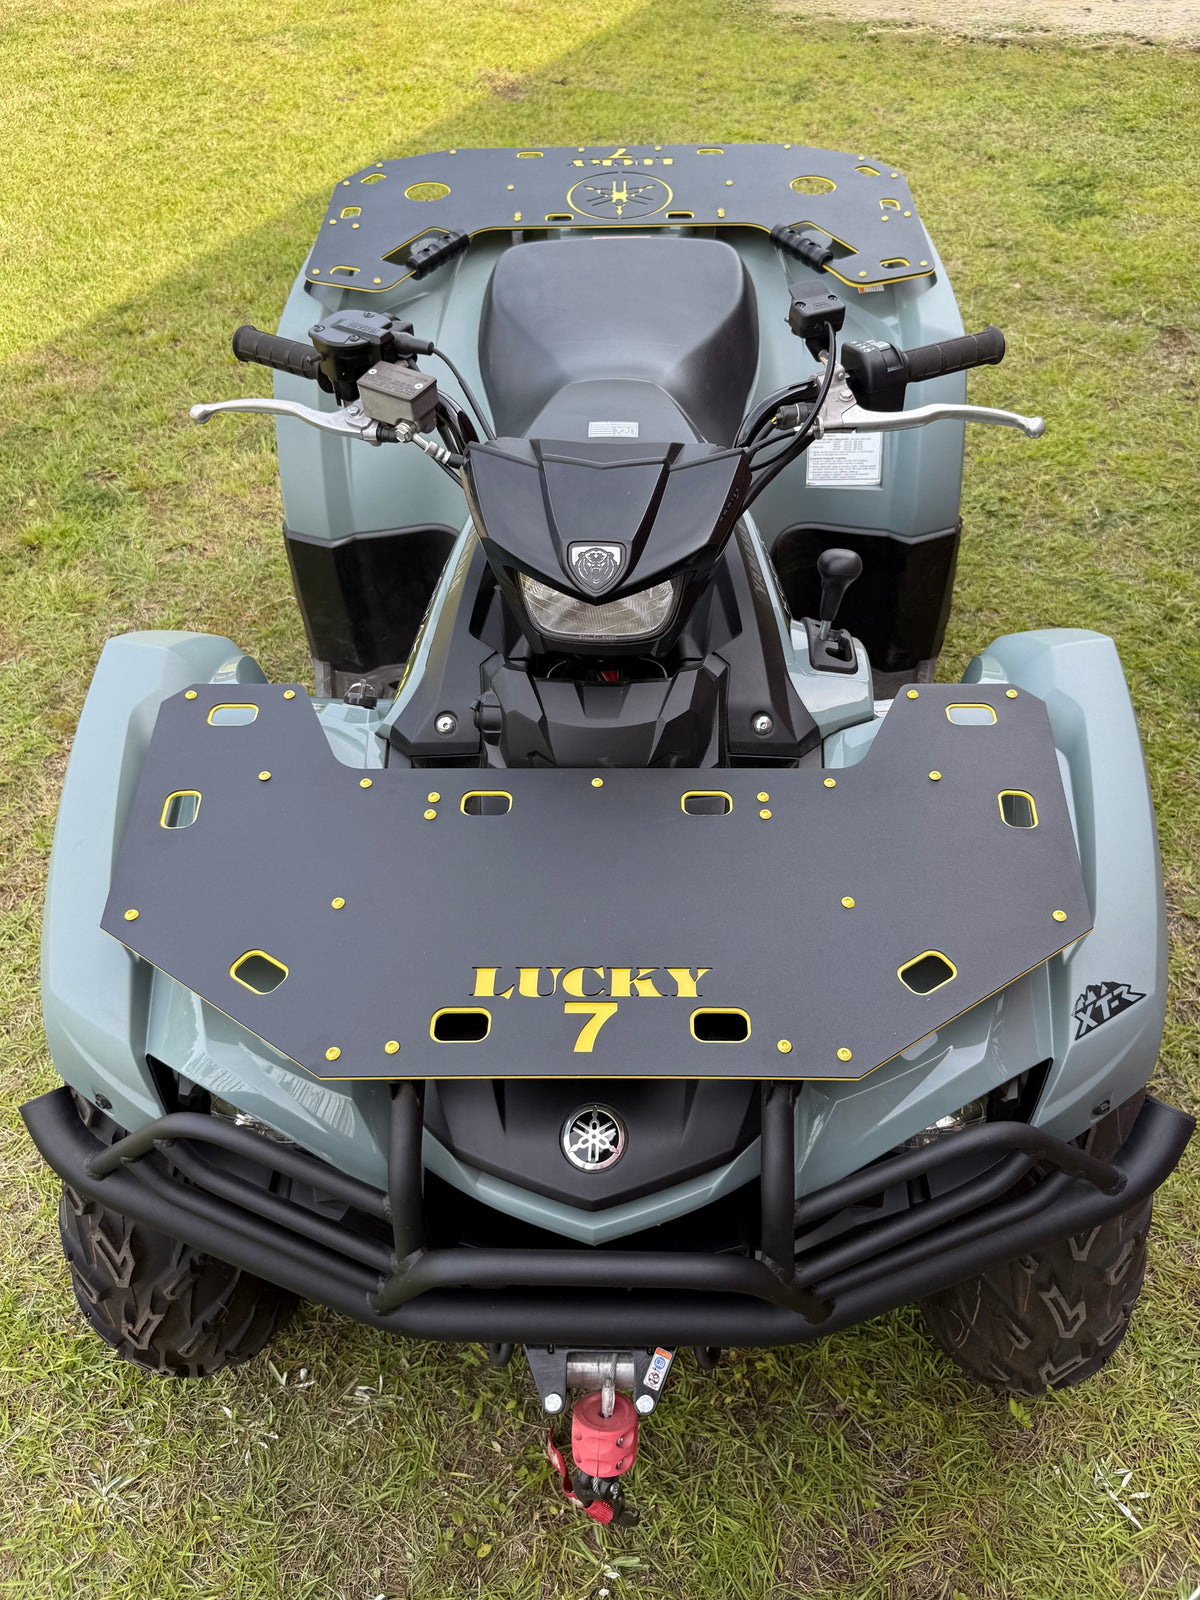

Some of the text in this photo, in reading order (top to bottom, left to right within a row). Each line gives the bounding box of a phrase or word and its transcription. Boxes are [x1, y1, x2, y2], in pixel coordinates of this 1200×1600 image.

[567, 157, 673, 167] LUCKY
[608, 147, 632, 158] 7
[469, 965, 713, 1000] LUCKY
[564, 1001, 618, 1053] 7
[1075, 986, 1142, 1036] XT-R
